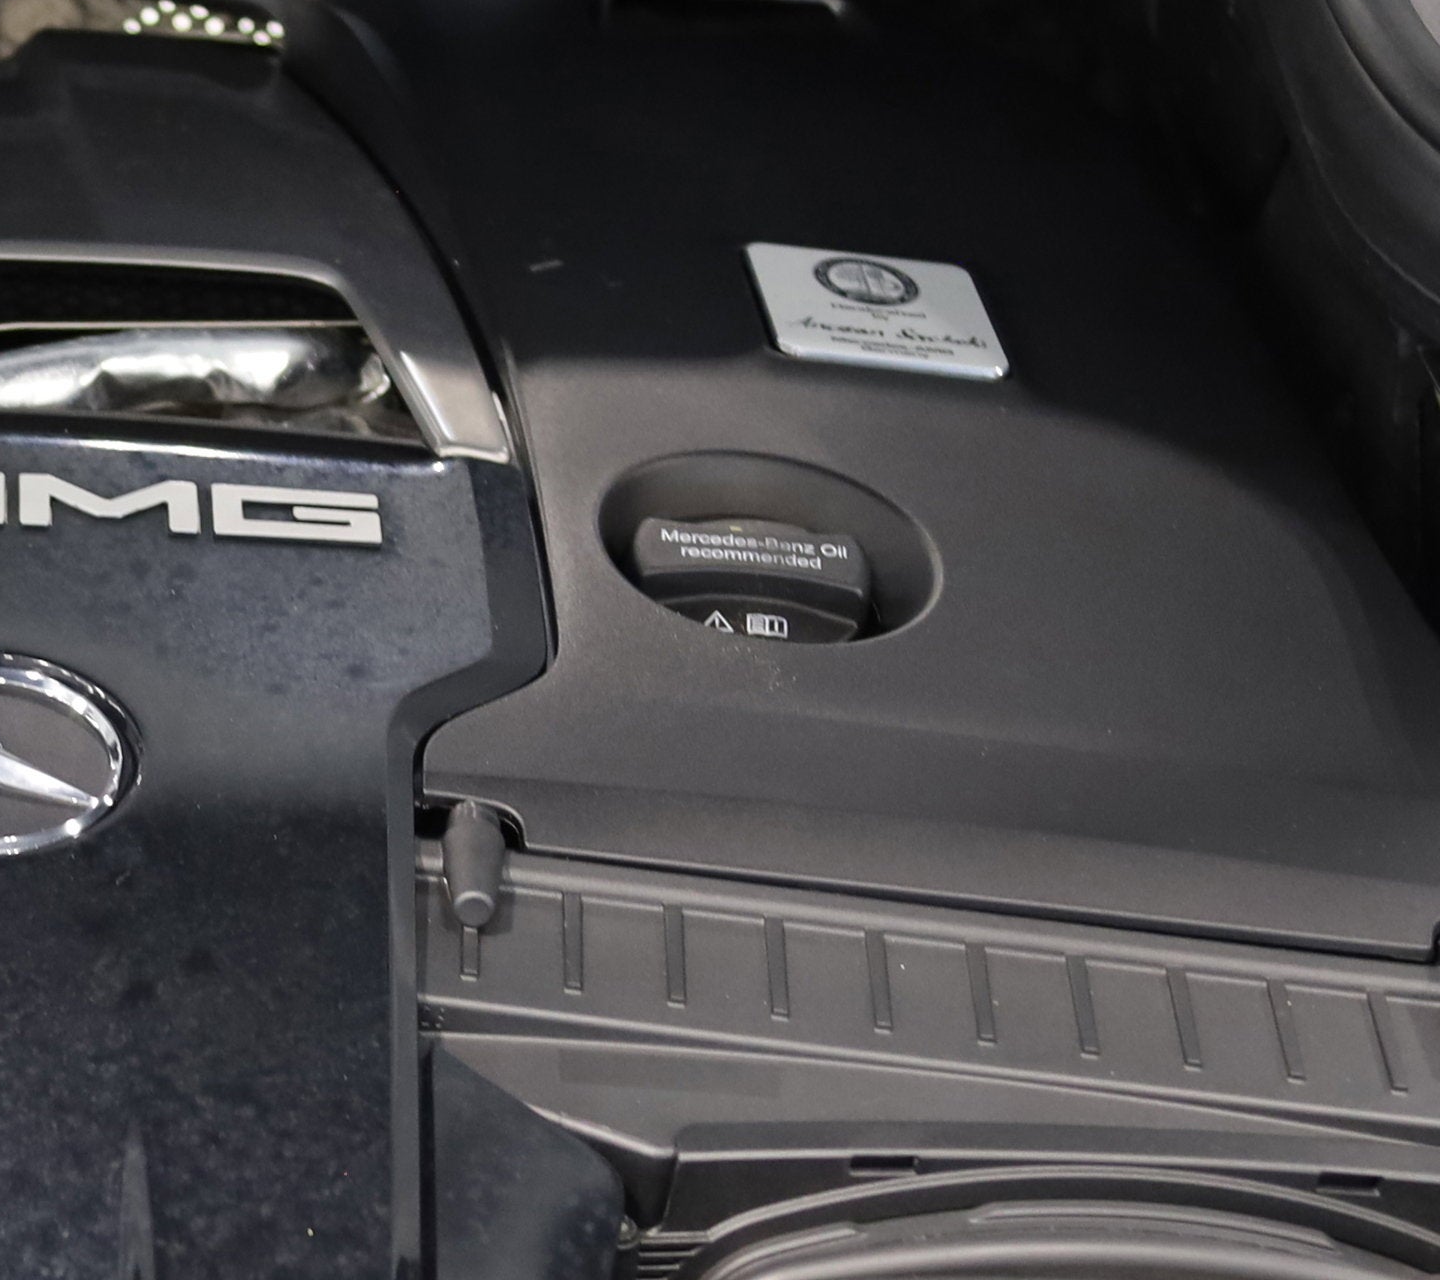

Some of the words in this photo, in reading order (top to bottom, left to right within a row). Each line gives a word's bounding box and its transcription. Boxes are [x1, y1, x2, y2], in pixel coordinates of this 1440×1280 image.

[660, 528, 815, 556] Mercedes-Benz
[820, 543, 848, 560] Oil
[680, 545, 822, 570] recommended
